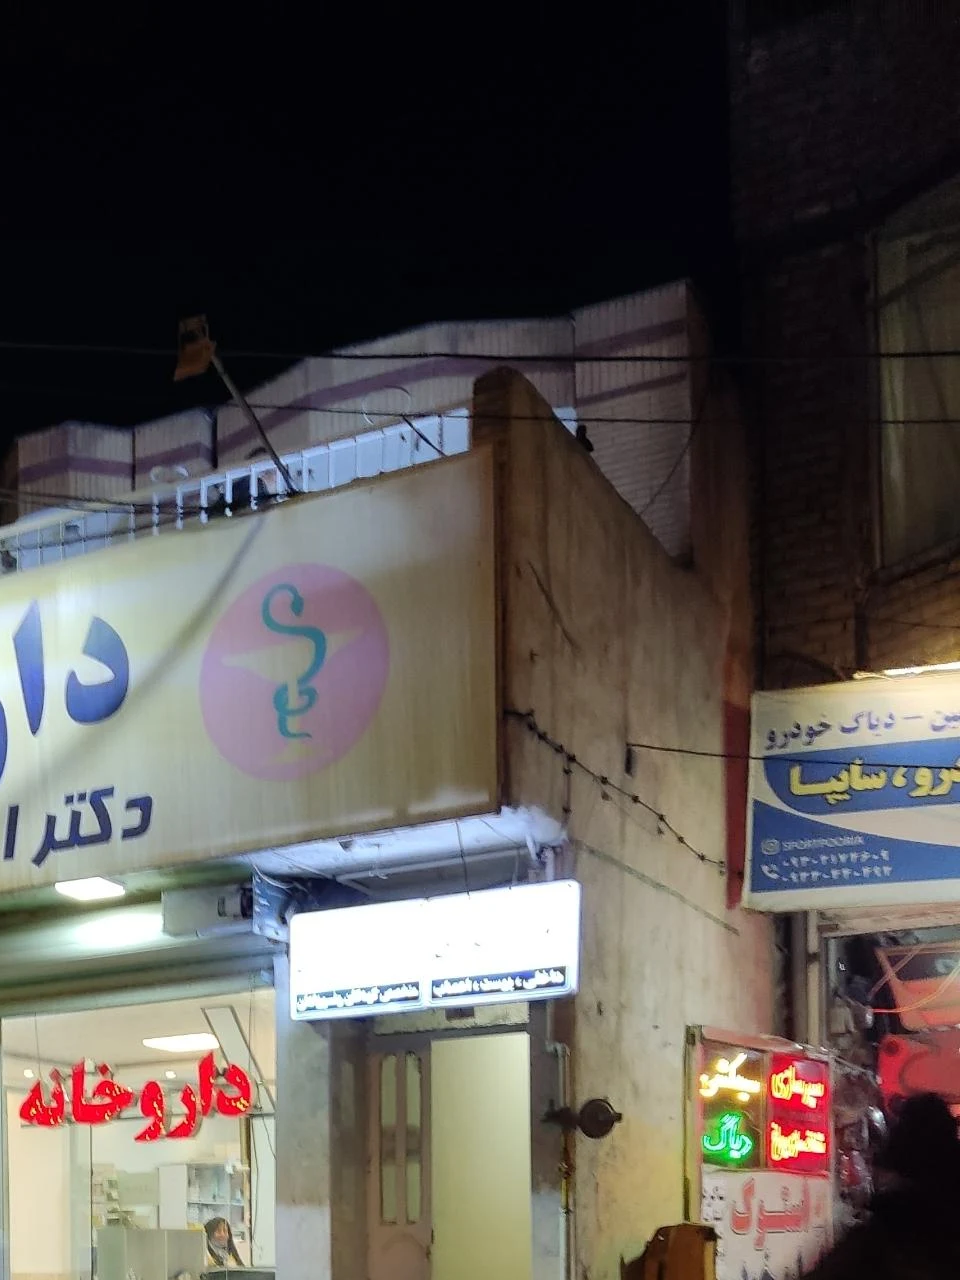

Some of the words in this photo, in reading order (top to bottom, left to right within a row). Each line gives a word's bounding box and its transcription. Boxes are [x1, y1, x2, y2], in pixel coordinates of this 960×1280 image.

[789, 757, 889, 805] سایپا
[39, 785, 154, 873] دکتر
[19, 1050, 252, 1143] داروخانه
[703, 1113, 754, 1158] دیاگ
